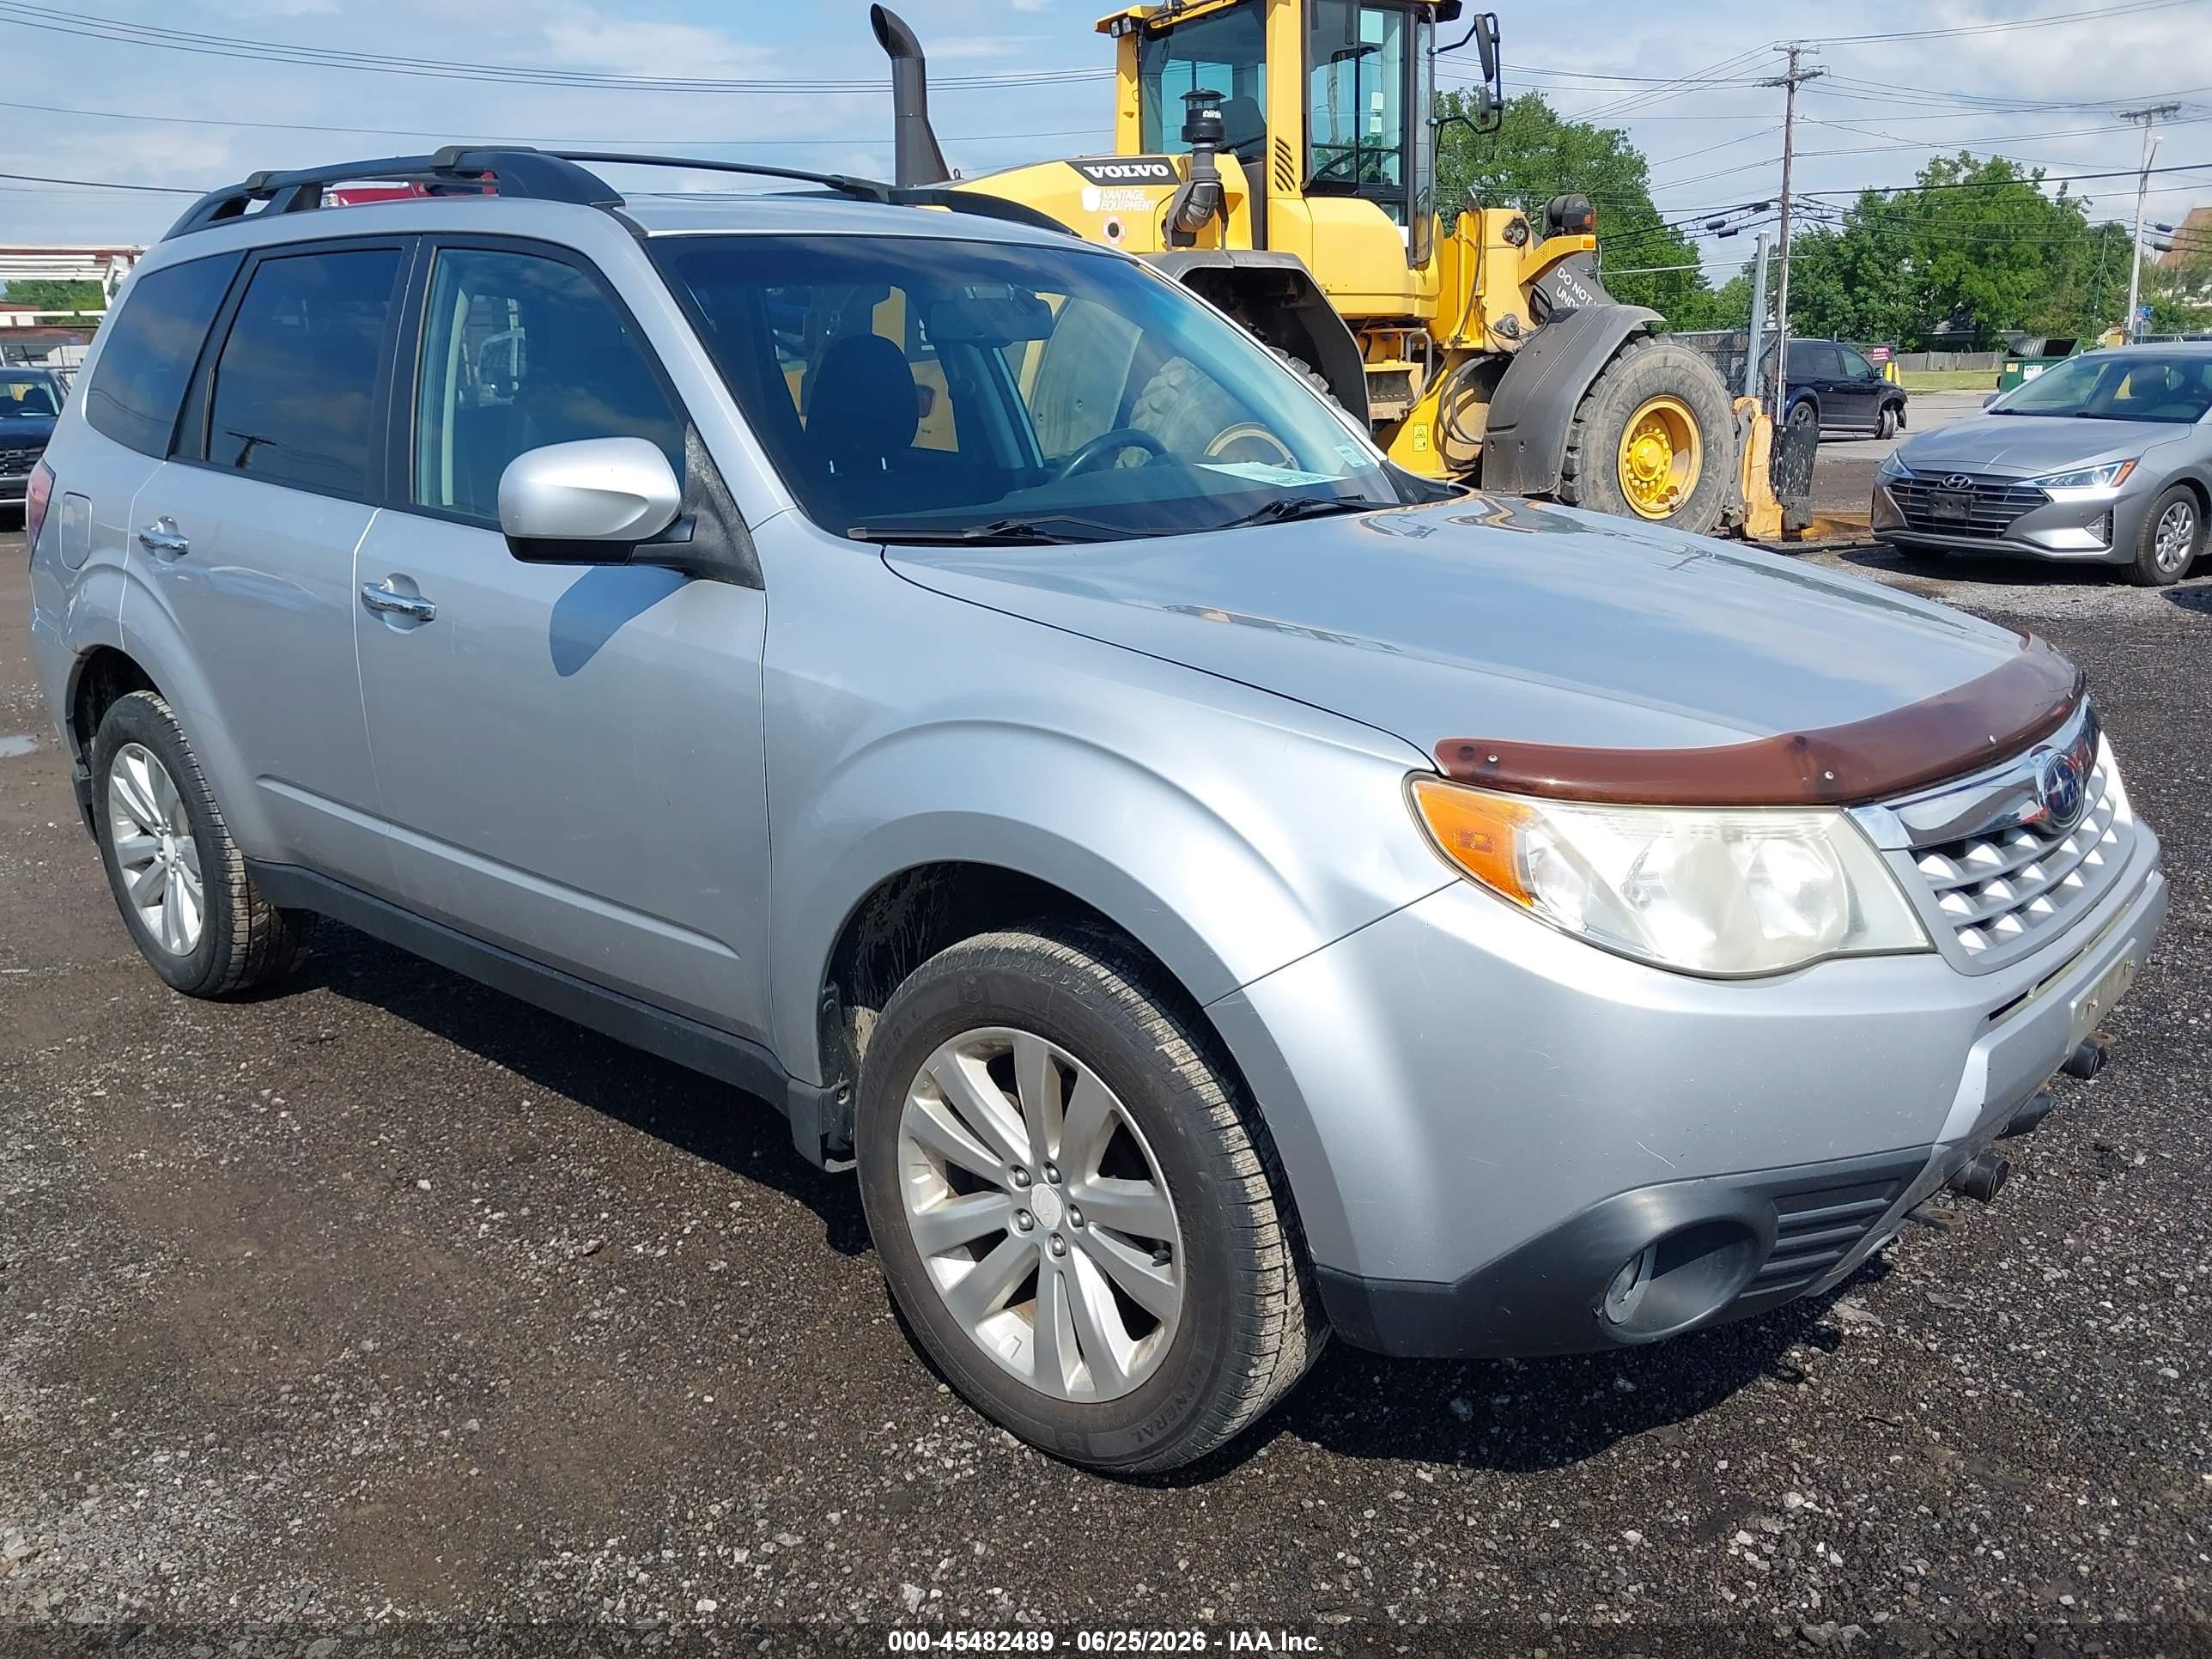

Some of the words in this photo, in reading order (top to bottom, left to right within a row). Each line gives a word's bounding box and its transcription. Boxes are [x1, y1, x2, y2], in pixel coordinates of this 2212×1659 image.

[1083, 163, 1169, 179] VOLVO
[1101, 188, 1146, 201] VANTAGE
[1100, 199, 1154, 211] EQUIPMENT
[1557, 266, 1572, 285] DO
[1571, 281, 1593, 305] NOT
